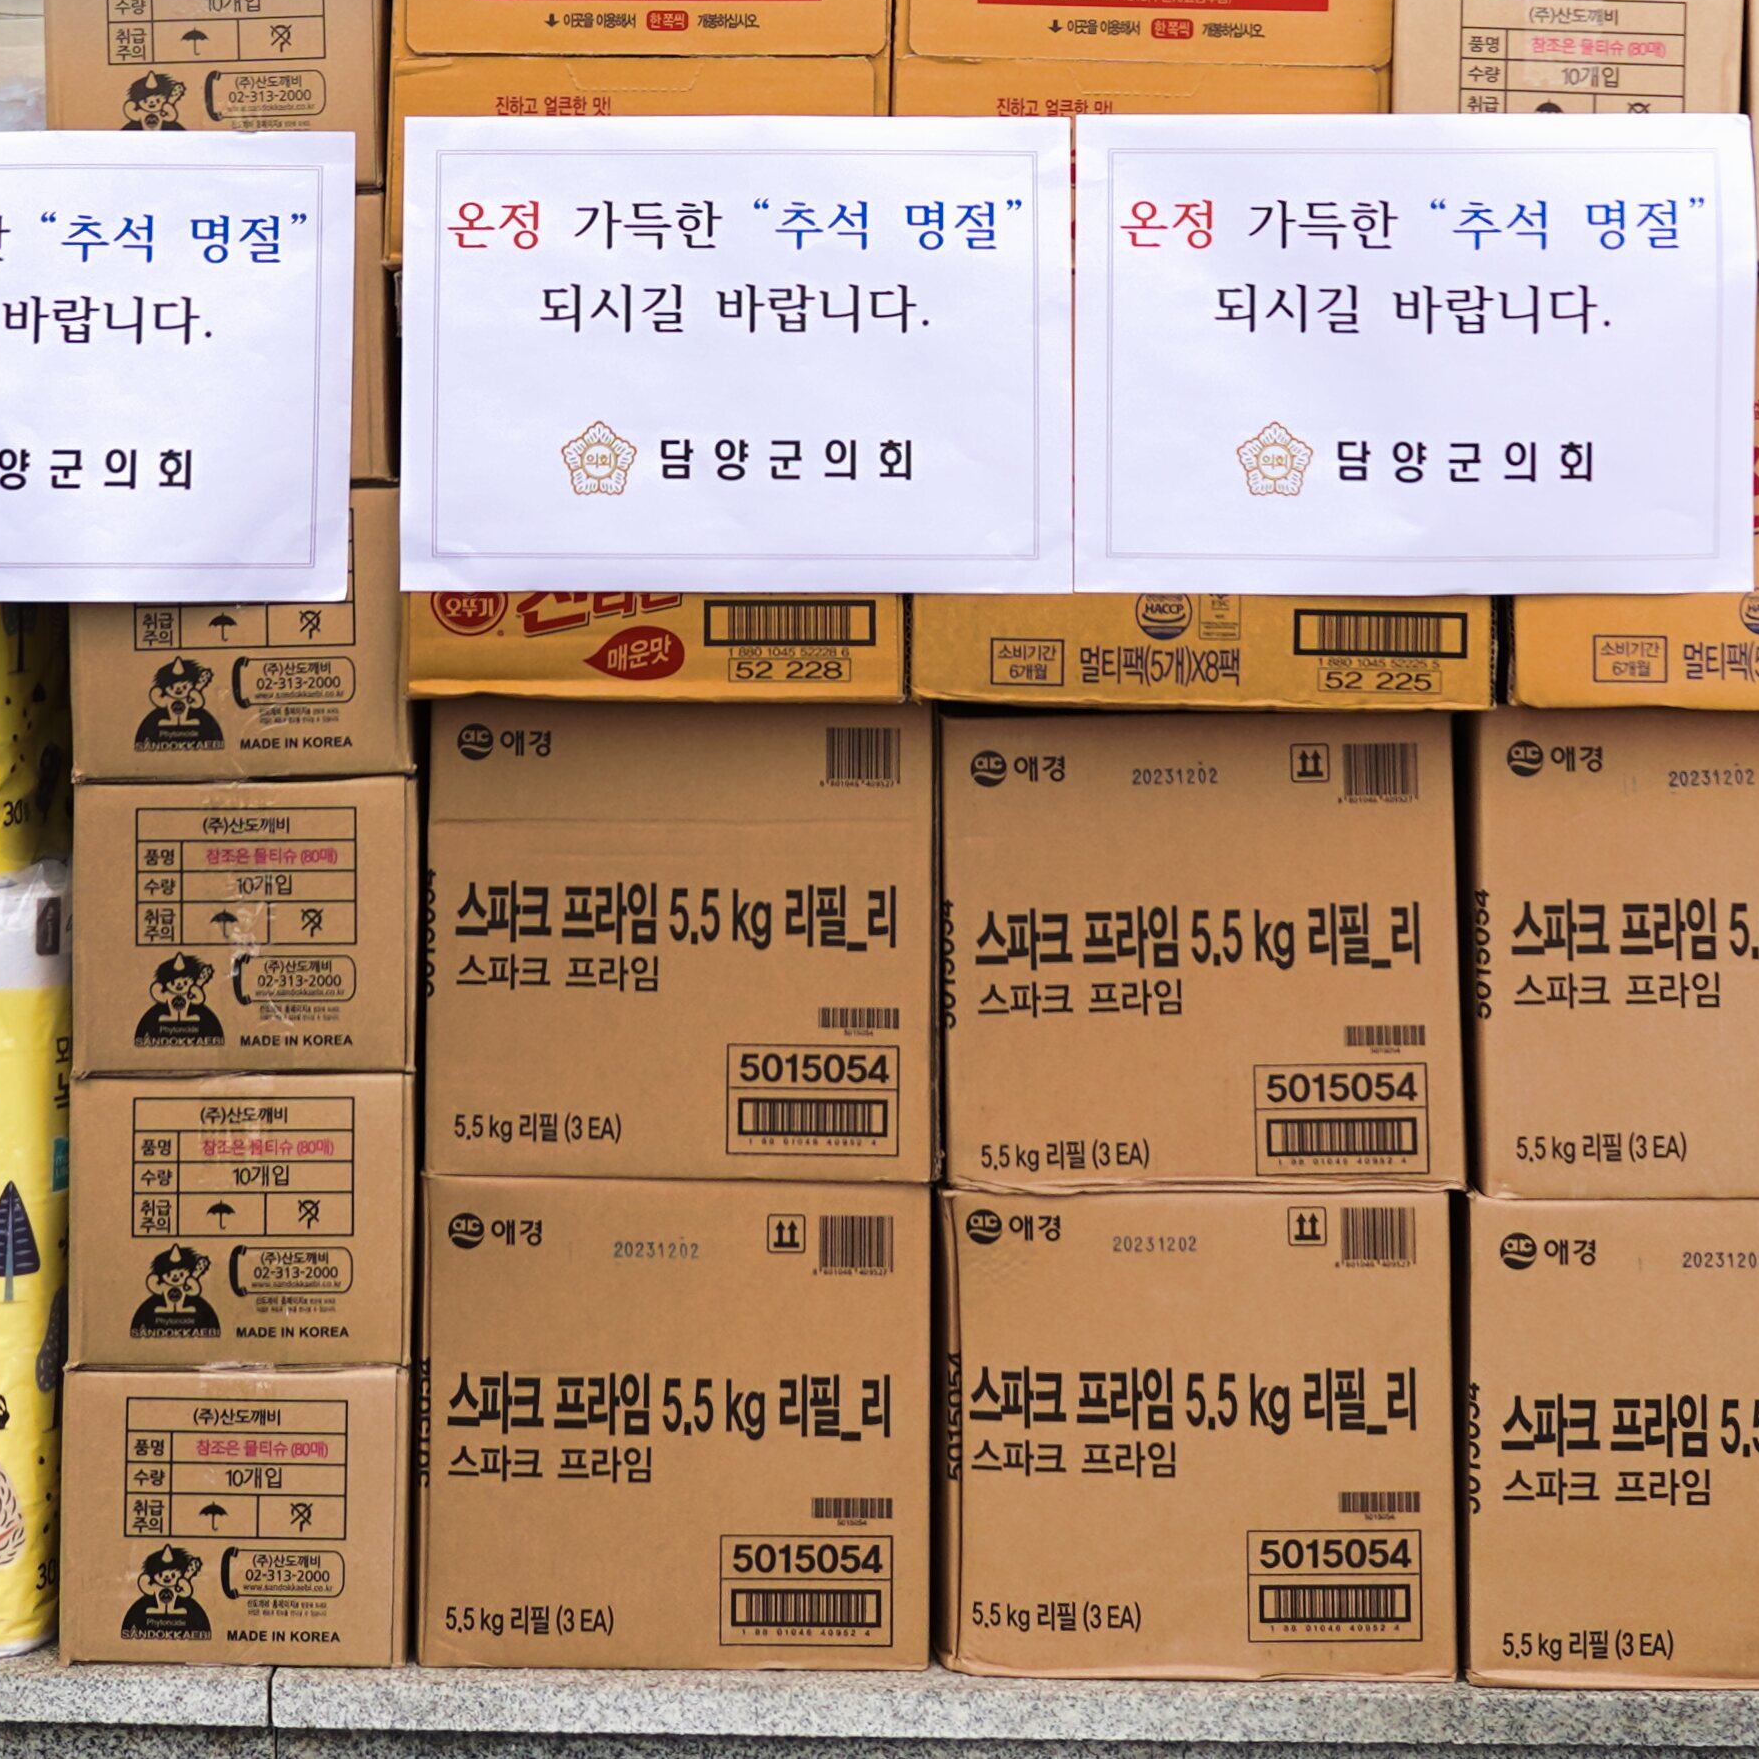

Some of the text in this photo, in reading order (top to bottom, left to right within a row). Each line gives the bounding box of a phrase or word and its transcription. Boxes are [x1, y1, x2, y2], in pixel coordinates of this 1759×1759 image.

[563, 13, 594, 29] 이곳을
[496, 97, 538, 116] 진하고
[544, 97, 587, 116] 얼큰한
[40, 211, 155, 265] “추석
[189, 210, 306, 264] 명절”
[448, 197, 1023, 252] 온정 가득한 “추석 명절”
[1120, 197, 1705, 252] 온정 가득한 “추석 명절”
[3, 292, 213, 345] 바랍니다.
[539, 283, 930, 335] 되시길 바랍니다.
[1214, 283, 1610, 335] 되시길 바랍니다.
[660, 437, 915, 482] 담양군의회
[1338, 438, 1595, 482] 담양군의회
[446, 597, 496, 619] 오뚜기
[607, 635, 672, 670] 매운맛
[1600, 641, 1660, 657] 소비기간
[736, 661, 843, 679] 52 228
[1325, 672, 1433, 691] 52 225
[500, 730, 552, 757] 애경
[455, 880, 897, 952] 스파크 프라임 5.5 kg 리필_리
[1512, 898, 1610, 961] 스파크
[1620, 898, 1716, 960] 프라임
[975, 901, 1421, 970] 스파크 프라임 5.5 kg 리필_리
[740, 1054, 889, 1083] 5015054
[1267, 1073, 1417, 1102] 5015054
[1545, 1239, 1596, 1266] 애경
[193, 1408, 281, 1426] (주)산도깨비
[134, 1439, 164, 1456] 품명
[197, 1440, 240, 1456] 참조은
[291, 1441, 328, 1458] (80매)
[134, 1468, 282, 1489] 수량 10개입
[1503, 1469, 1711, 1506] 스파크 프라임
[133, 1500, 164, 1516] 취급
[133, 1517, 163, 1533] 주의
[246, 1569, 330, 1582] 02-313-2000
[253, 1555, 320, 1569] (주)산도깨비
[227, 1630, 266, 1641] MADE
[272, 1631, 284, 1641] IN
[290, 1631, 340, 1642] KOREA
[1539, 1630, 1562, 1661] kg
[1569, 1630, 1609, 1660] 리필
[1616, 1630, 1635, 1659] (3
[1640, 1630, 1673, 1659] EA)
